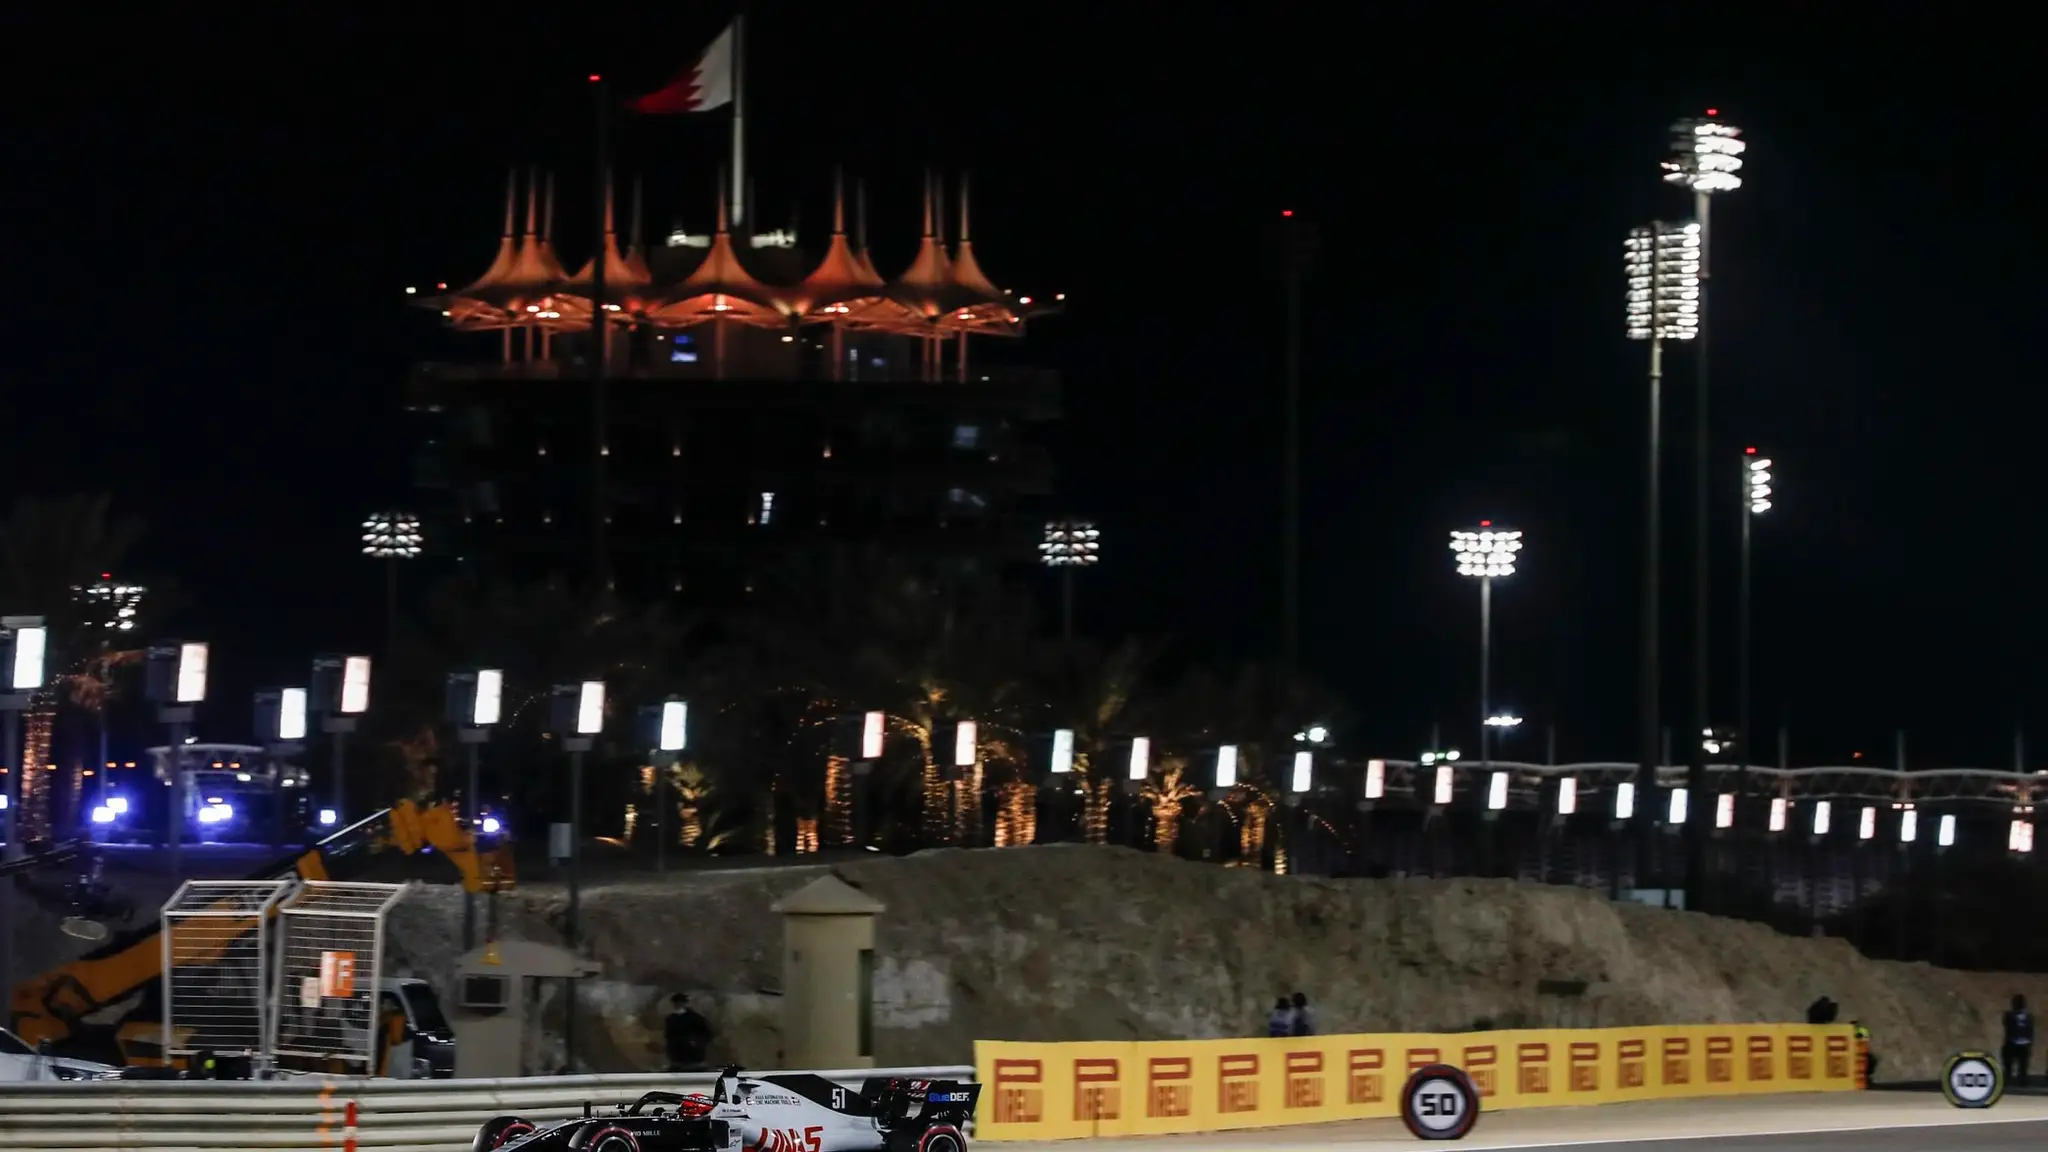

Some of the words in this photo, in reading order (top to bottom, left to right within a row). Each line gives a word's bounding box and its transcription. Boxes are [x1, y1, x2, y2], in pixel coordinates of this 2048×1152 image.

[1957, 1073, 1988, 1087] 100
[832, 1088, 846, 1109] 51
[1421, 1093, 1456, 1116] 50
